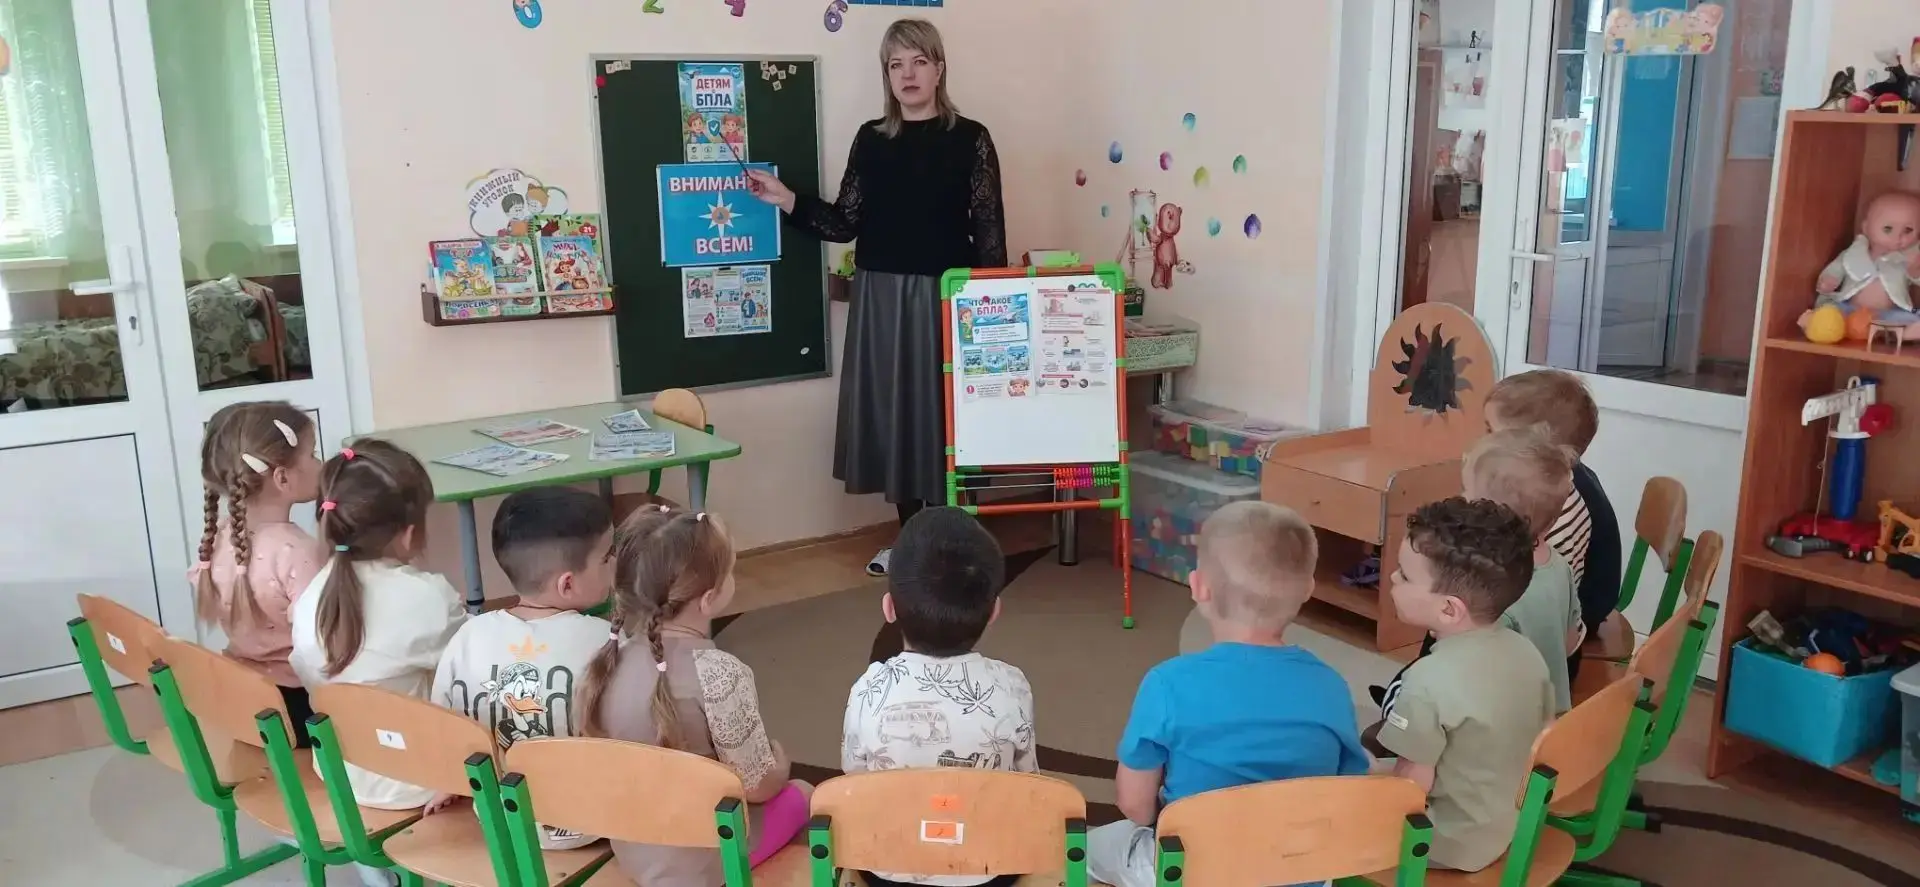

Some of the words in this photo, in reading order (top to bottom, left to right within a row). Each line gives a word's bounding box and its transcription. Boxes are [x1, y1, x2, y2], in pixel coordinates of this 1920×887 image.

[696, 78, 731, 90] ДЕТЯМ
[696, 93, 732, 106] БПЛА
[669, 175, 749, 192] ВНИМАН
[482, 184, 514, 208] УГОЛОК
[696, 236, 753, 254] ВСЕМ!
[977, 305, 1008, 315] БПЛА?
